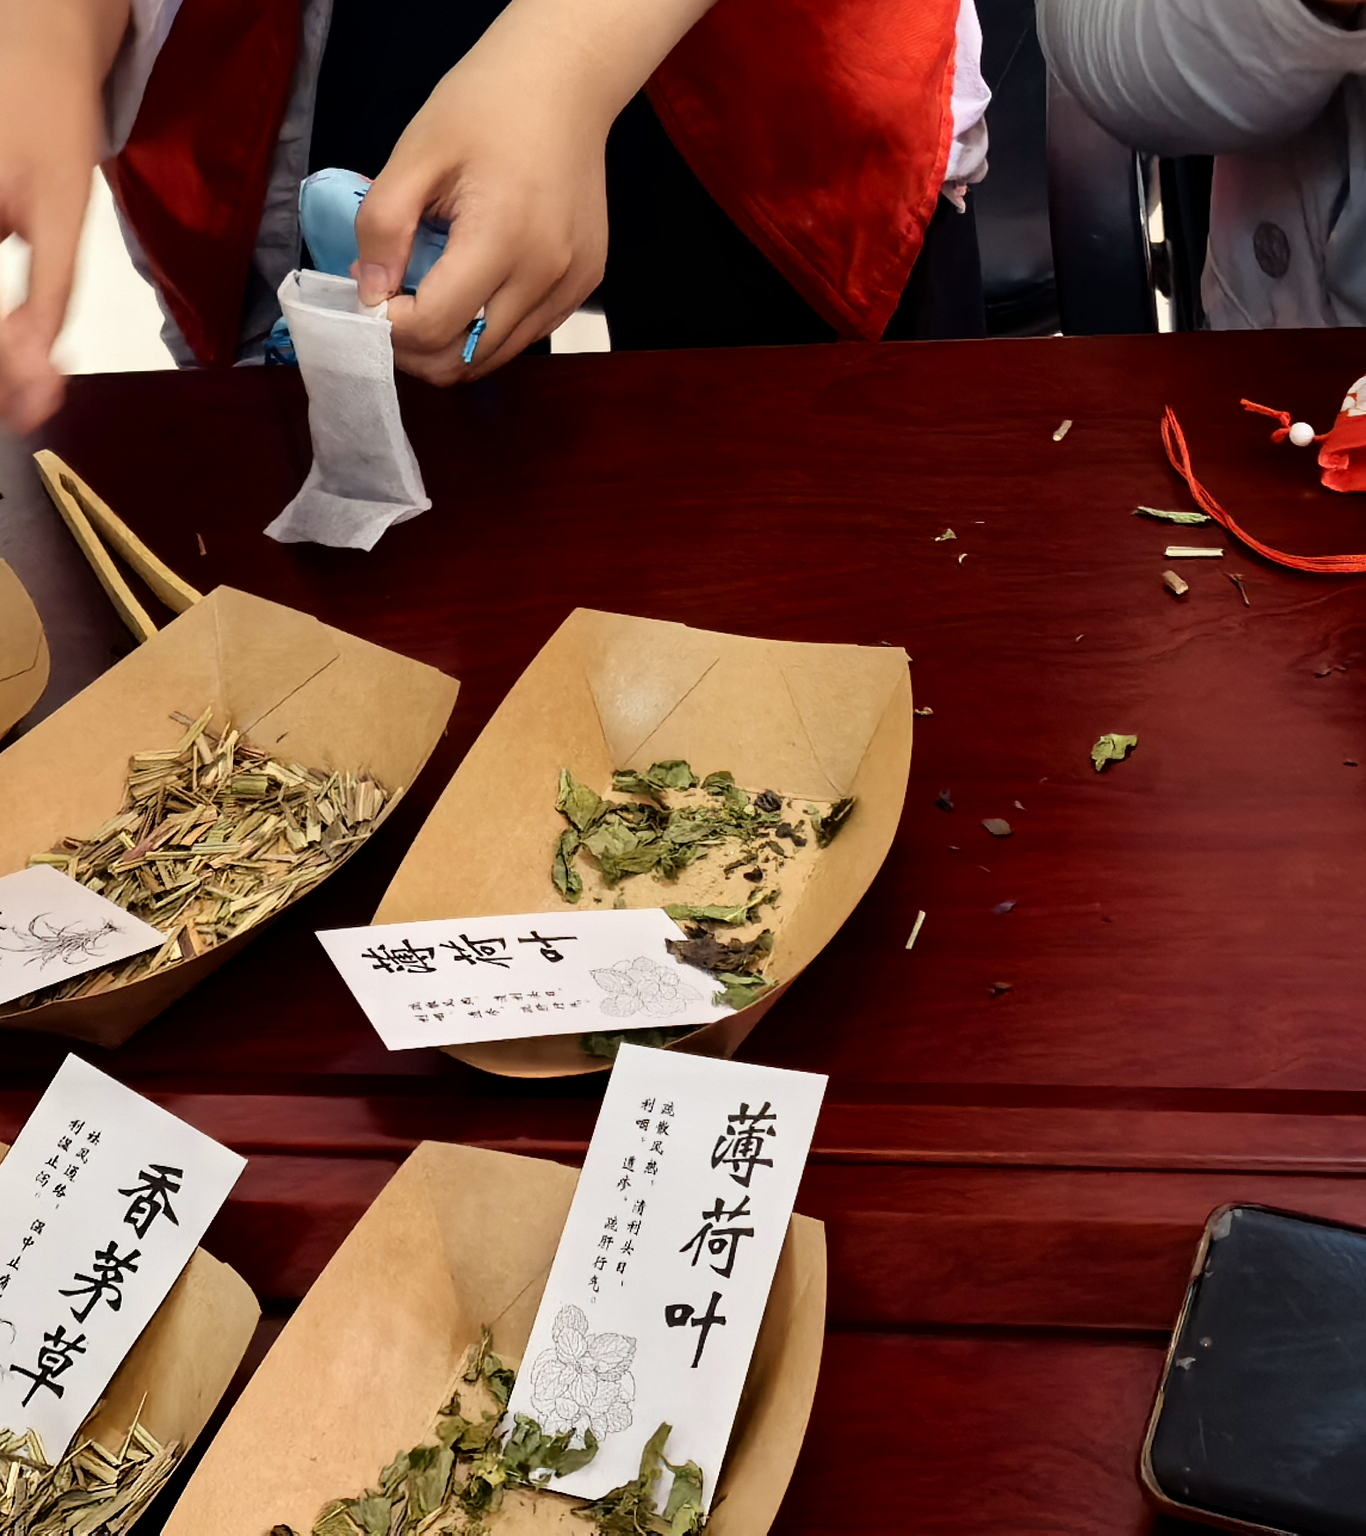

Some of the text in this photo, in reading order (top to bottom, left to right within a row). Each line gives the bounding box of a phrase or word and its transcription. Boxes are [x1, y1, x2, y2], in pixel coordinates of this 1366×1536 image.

[361, 930, 578, 974] 薄荷叶
[8, 1163, 185, 1408] 香茅草
[664, 1101, 777, 1369] 薄荷叶
